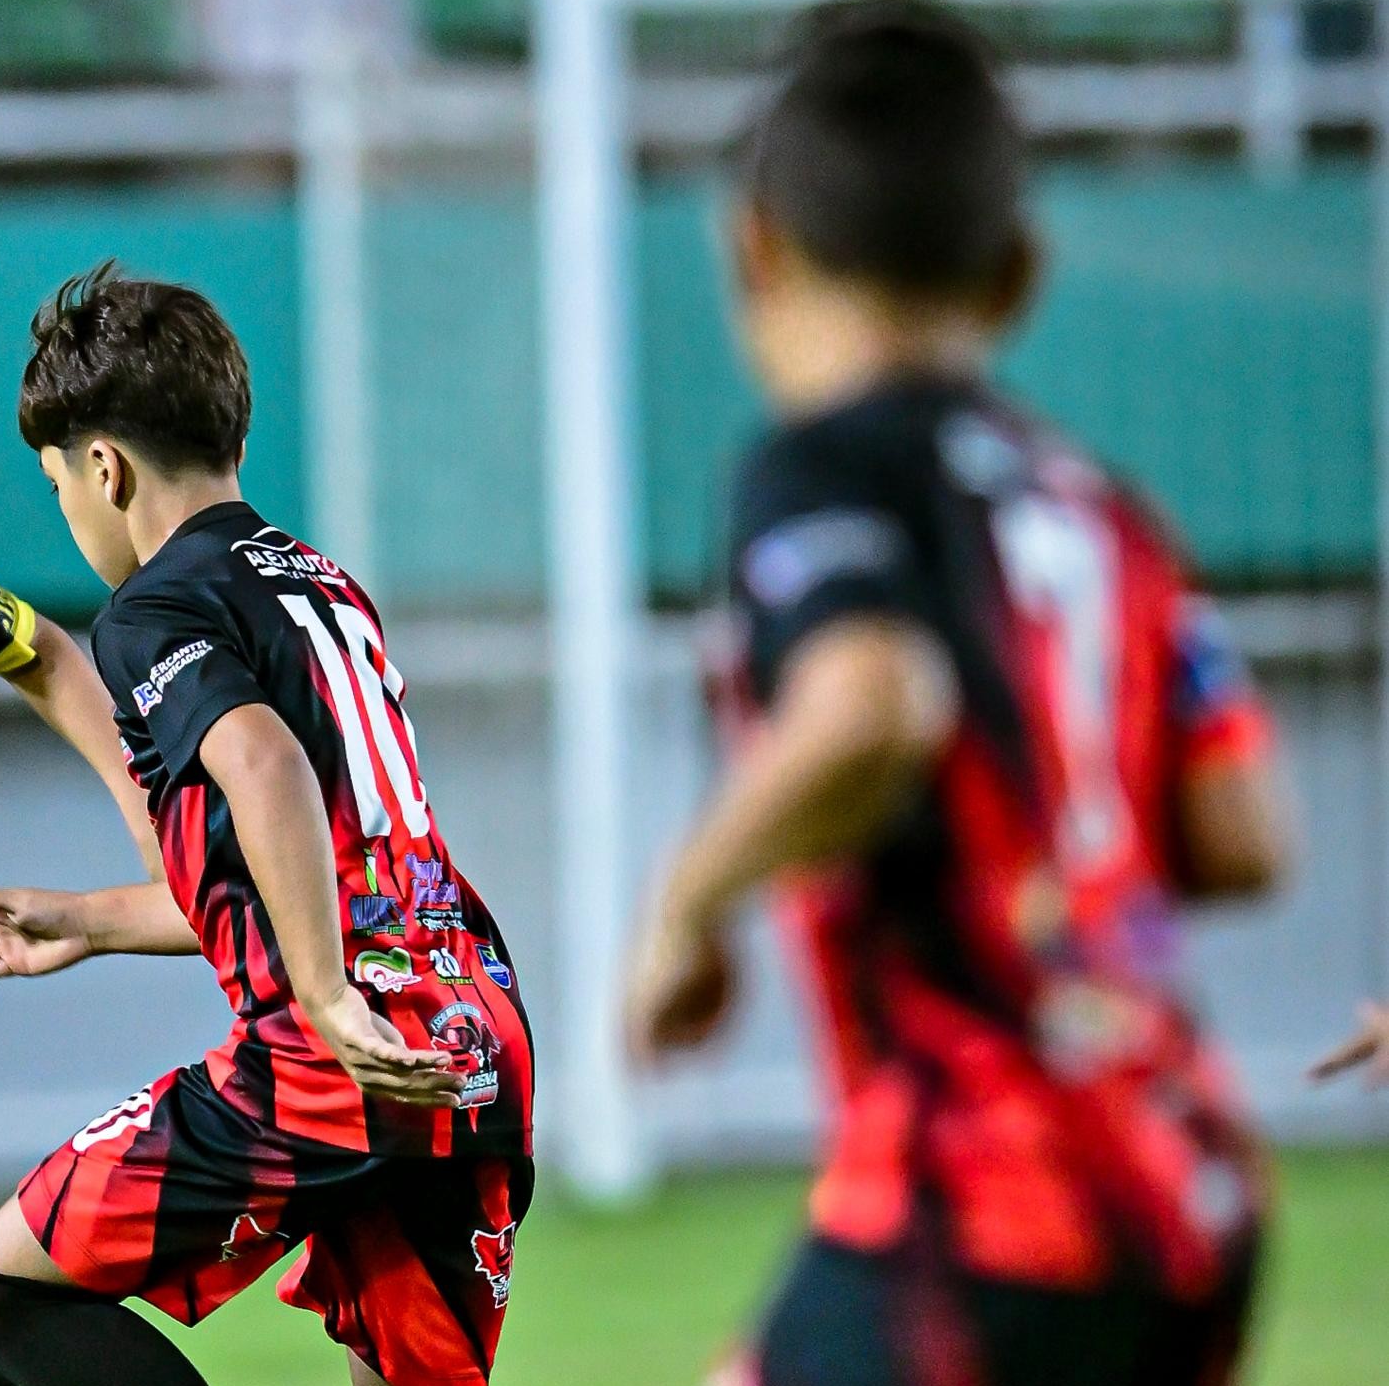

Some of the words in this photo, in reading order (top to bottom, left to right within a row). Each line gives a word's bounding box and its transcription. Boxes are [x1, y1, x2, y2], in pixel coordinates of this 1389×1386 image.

[288, 554, 340, 576] AUTO
[134, 683, 157, 707] JC
[277, 593, 431, 838] 10
